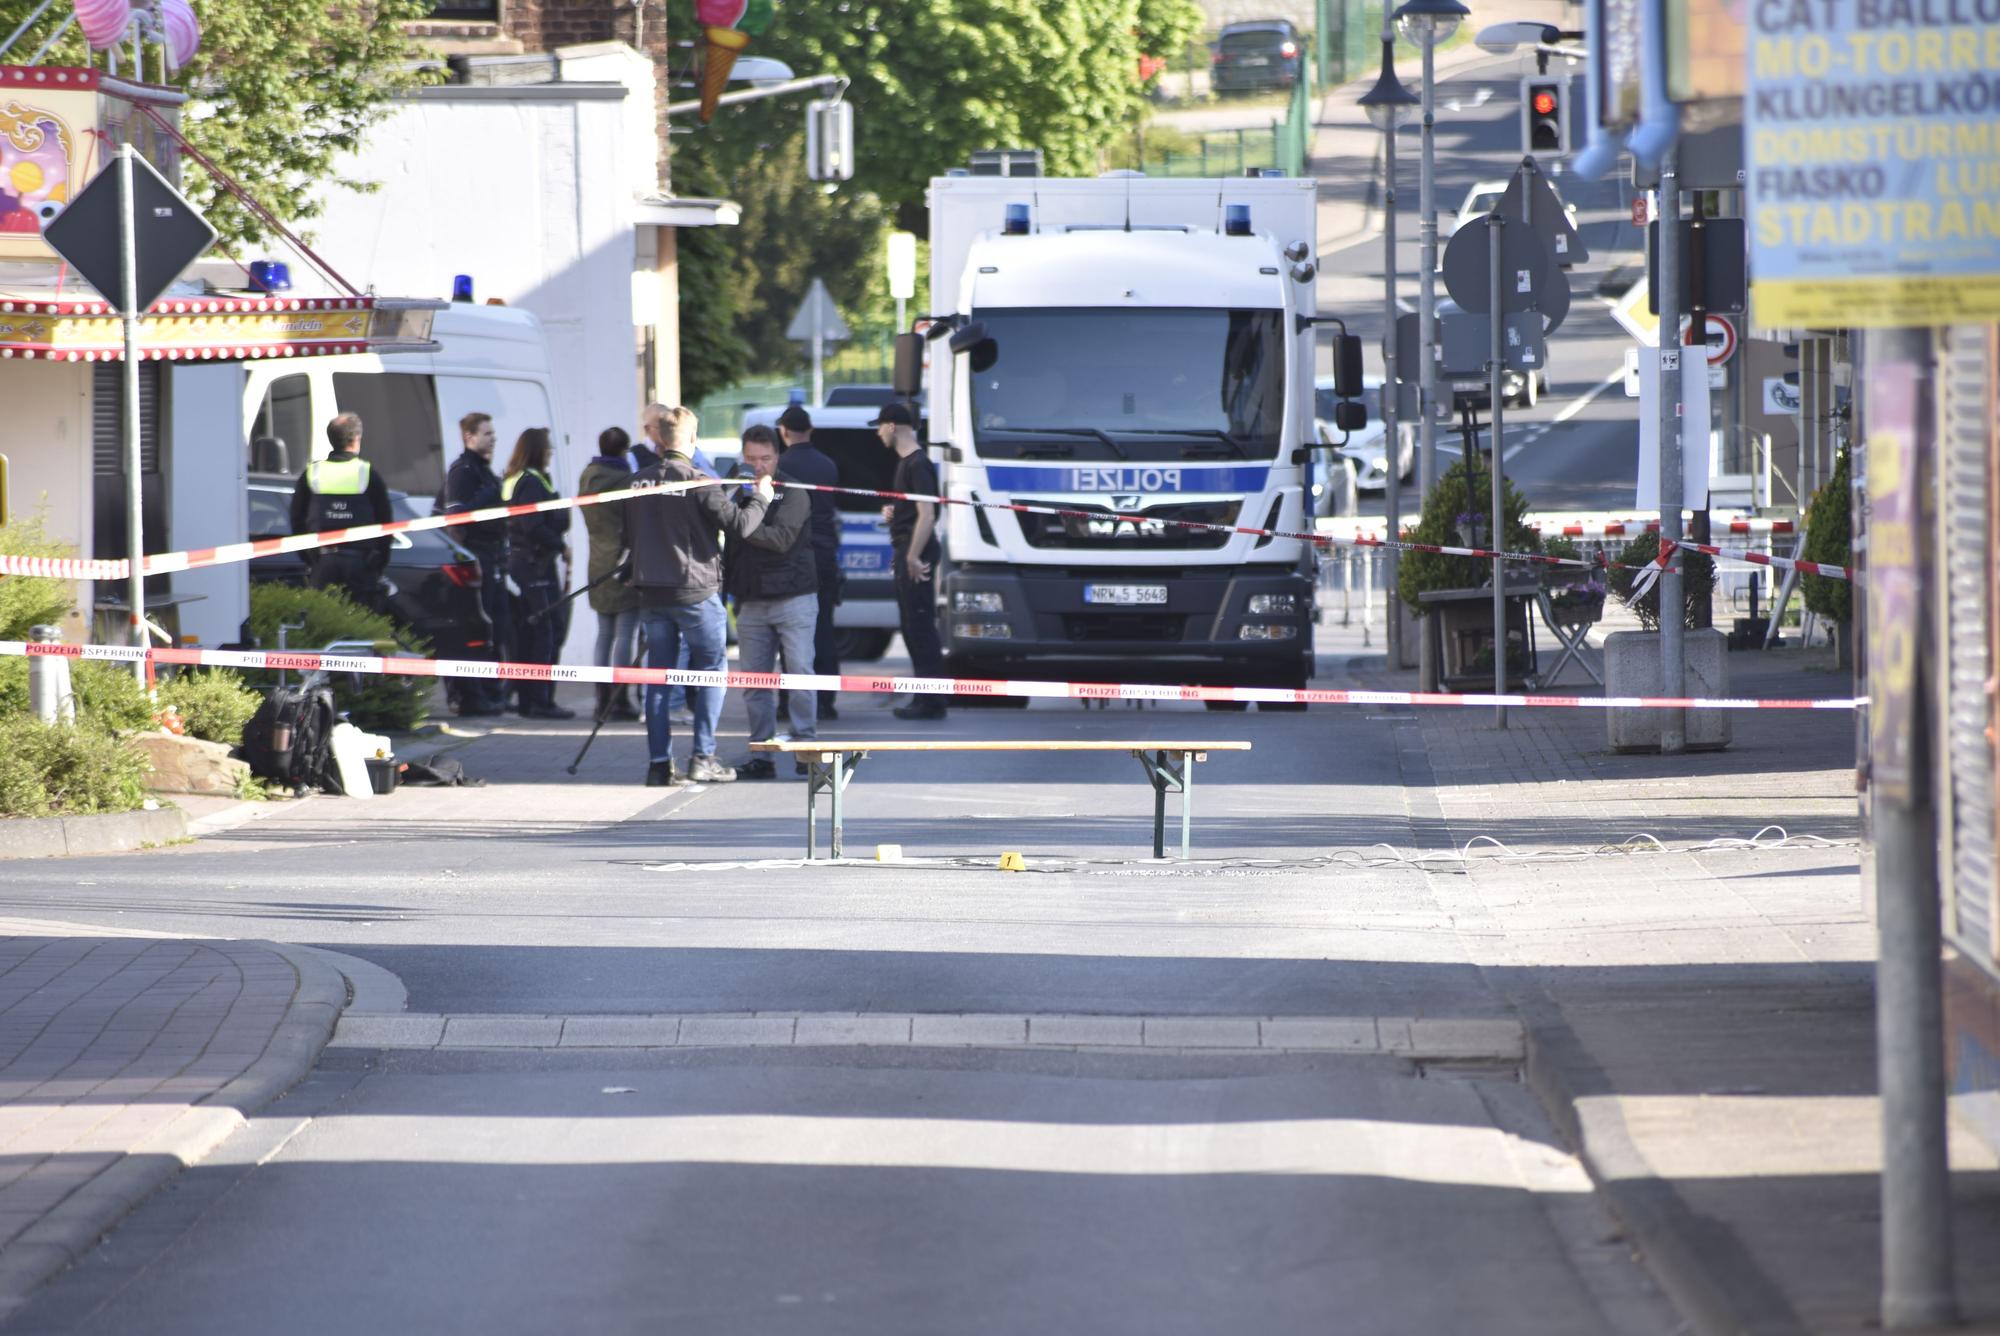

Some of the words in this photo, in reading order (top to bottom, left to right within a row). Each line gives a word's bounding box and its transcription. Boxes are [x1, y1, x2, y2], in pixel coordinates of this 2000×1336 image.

[1754, 0, 1841, 34] CAT
[1755, 73, 2000, 121] KLÜNGELKÖ
[1755, 118, 2000, 165] DOMSTÜRM
[1756, 166, 1886, 203] FIASKO
[630, 479, 687, 497] POLEI
[326, 511, 353, 519] Team
[1088, 520, 1165, 537] MAN
[1092, 587, 1116, 601] NRW
[1136, 588, 1167, 602] 5648
[26, 644, 152, 659] POLIZEIABSPERRUNG
[243, 655, 367, 669] POLIZEIABSPERRUNG
[455, 665, 578, 678] POLIZEIABSPERRUNG
[665, 674, 786, 686] POLIZEIABSPERRUNG
[1006, 855, 1012, 867] 1
